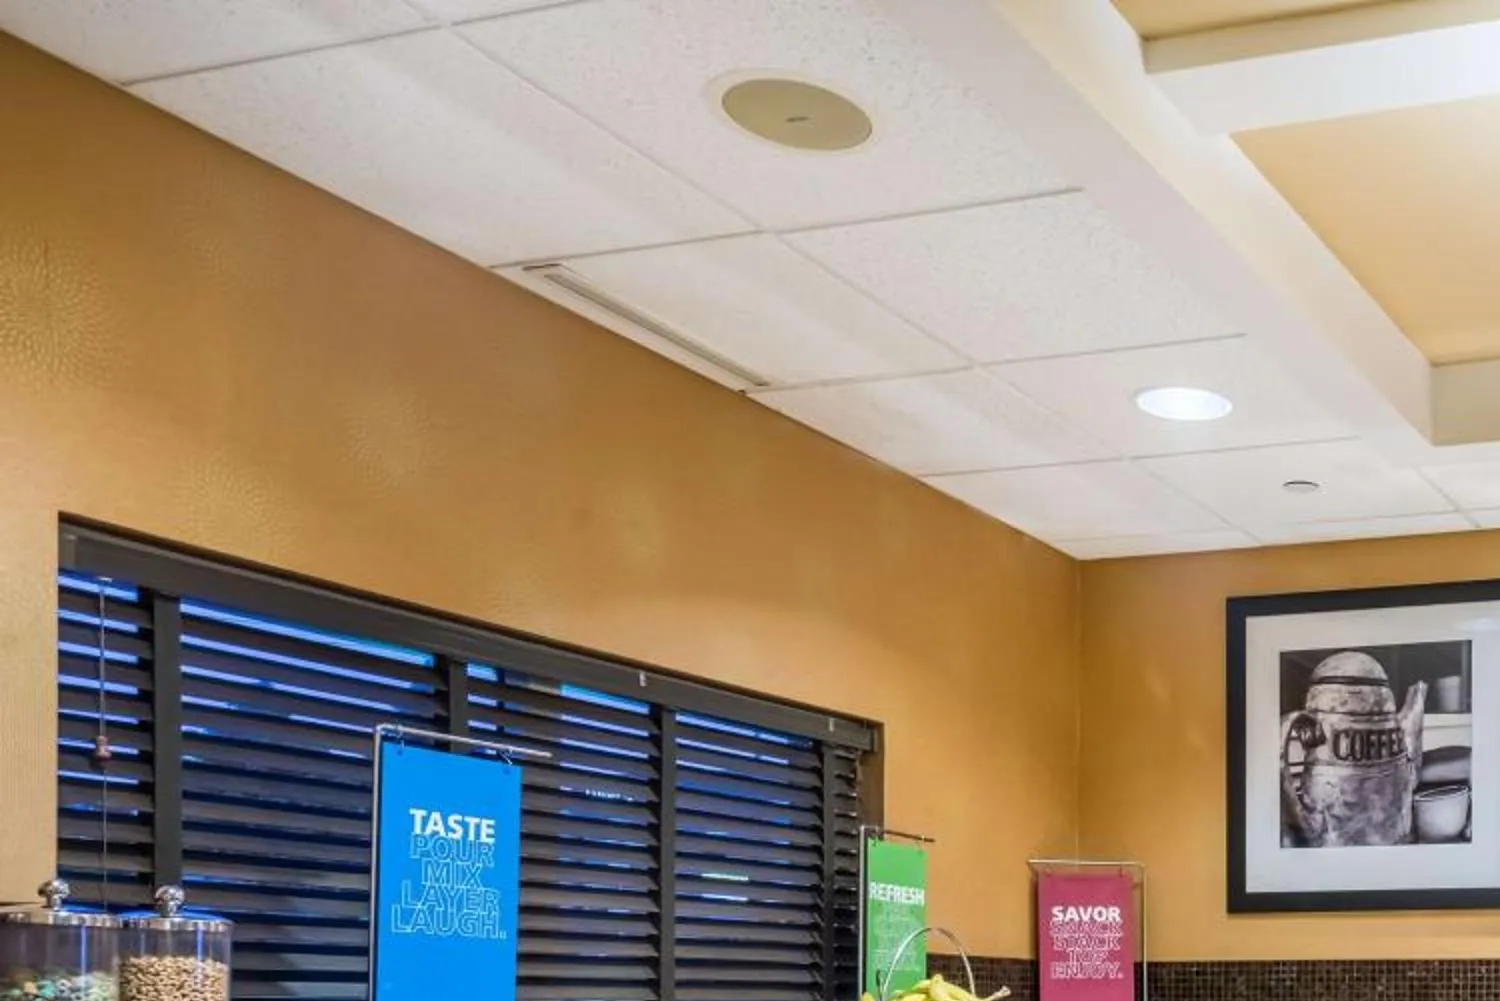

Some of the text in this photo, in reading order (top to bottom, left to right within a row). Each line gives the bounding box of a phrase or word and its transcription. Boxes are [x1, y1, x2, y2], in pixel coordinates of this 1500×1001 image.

[409, 807, 496, 844] TASTE
[409, 831, 495, 867] POUR
[421, 859, 482, 889] MIX
[402, 880, 501, 914] LAYER
[869, 882, 925, 906] REFRESH
[391, 904, 507, 940] LAUGH.
[1051, 905, 1121, 922] SAVOR
